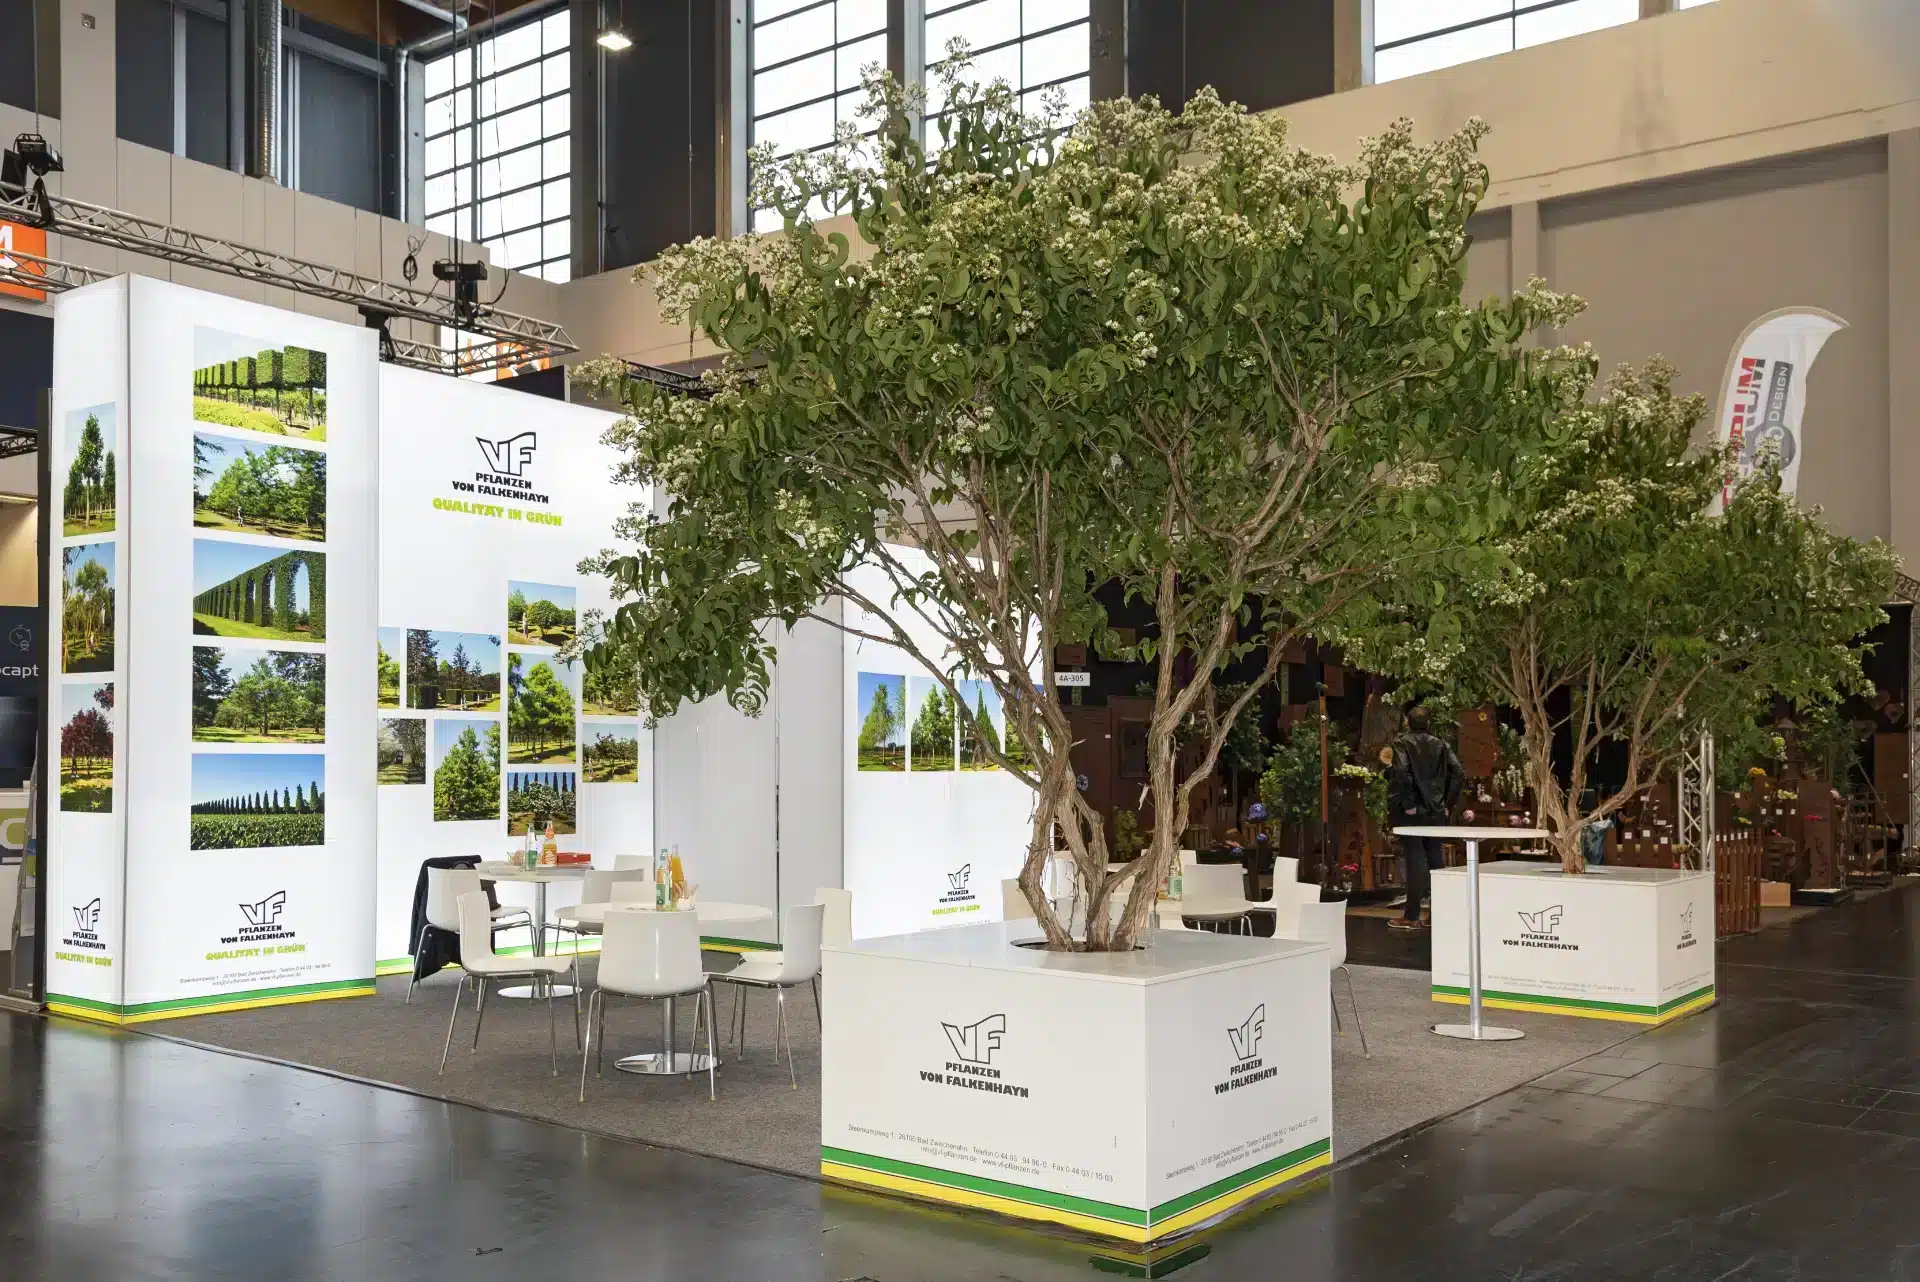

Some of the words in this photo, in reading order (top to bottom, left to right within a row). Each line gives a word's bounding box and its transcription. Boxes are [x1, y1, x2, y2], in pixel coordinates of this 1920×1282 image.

[1768, 366, 1789, 422] DESIGN
[475, 431, 536, 477] VF
[452, 480, 475, 493] VON
[477, 484, 549, 504] FALKENHAYN
[475, 472, 532, 490] PFLANZEN
[432, 497, 504, 518] QUALITÄT
[507, 508, 522, 521] IN
[526, 511, 562, 526] GRÜN
[0, 664, 39, 679] capt
[1059, 674, 1084, 682] 4A-305
[73, 897, 101, 932] VF
[239, 890, 286, 925] VF
[1517, 905, 1563, 934] VF
[72, 931, 98, 941] PFLANZEN
[220, 936, 238, 944] VON
[240, 931, 295, 942] FALKENHAYN
[238, 924, 282, 934] PFLANZEN
[1520, 933, 1560, 941] PFLANZEN
[62, 938, 73, 946] VON
[73, 939, 106, 950] FALKENHAYN
[1521, 940, 1579, 951] FALKENHAYN
[940, 1013, 1006, 1065] VF
[1227, 1003, 1265, 1060] VF
[945, 1061, 1001, 1079] PFLANZEN
[1230, 1058, 1263, 1076] PFLANZEN
[919, 1070, 943, 1084] VON
[946, 1075, 1029, 1098] FALKENHAYN
[1214, 1081, 1230, 1095] VON
[1230, 1066, 1278, 1090] FALKENHAYN
[917, 1136, 929, 1145] Bad
[972, 1146, 994, 1157] Telefon
[1052, 1162, 1064, 1172] Fax
